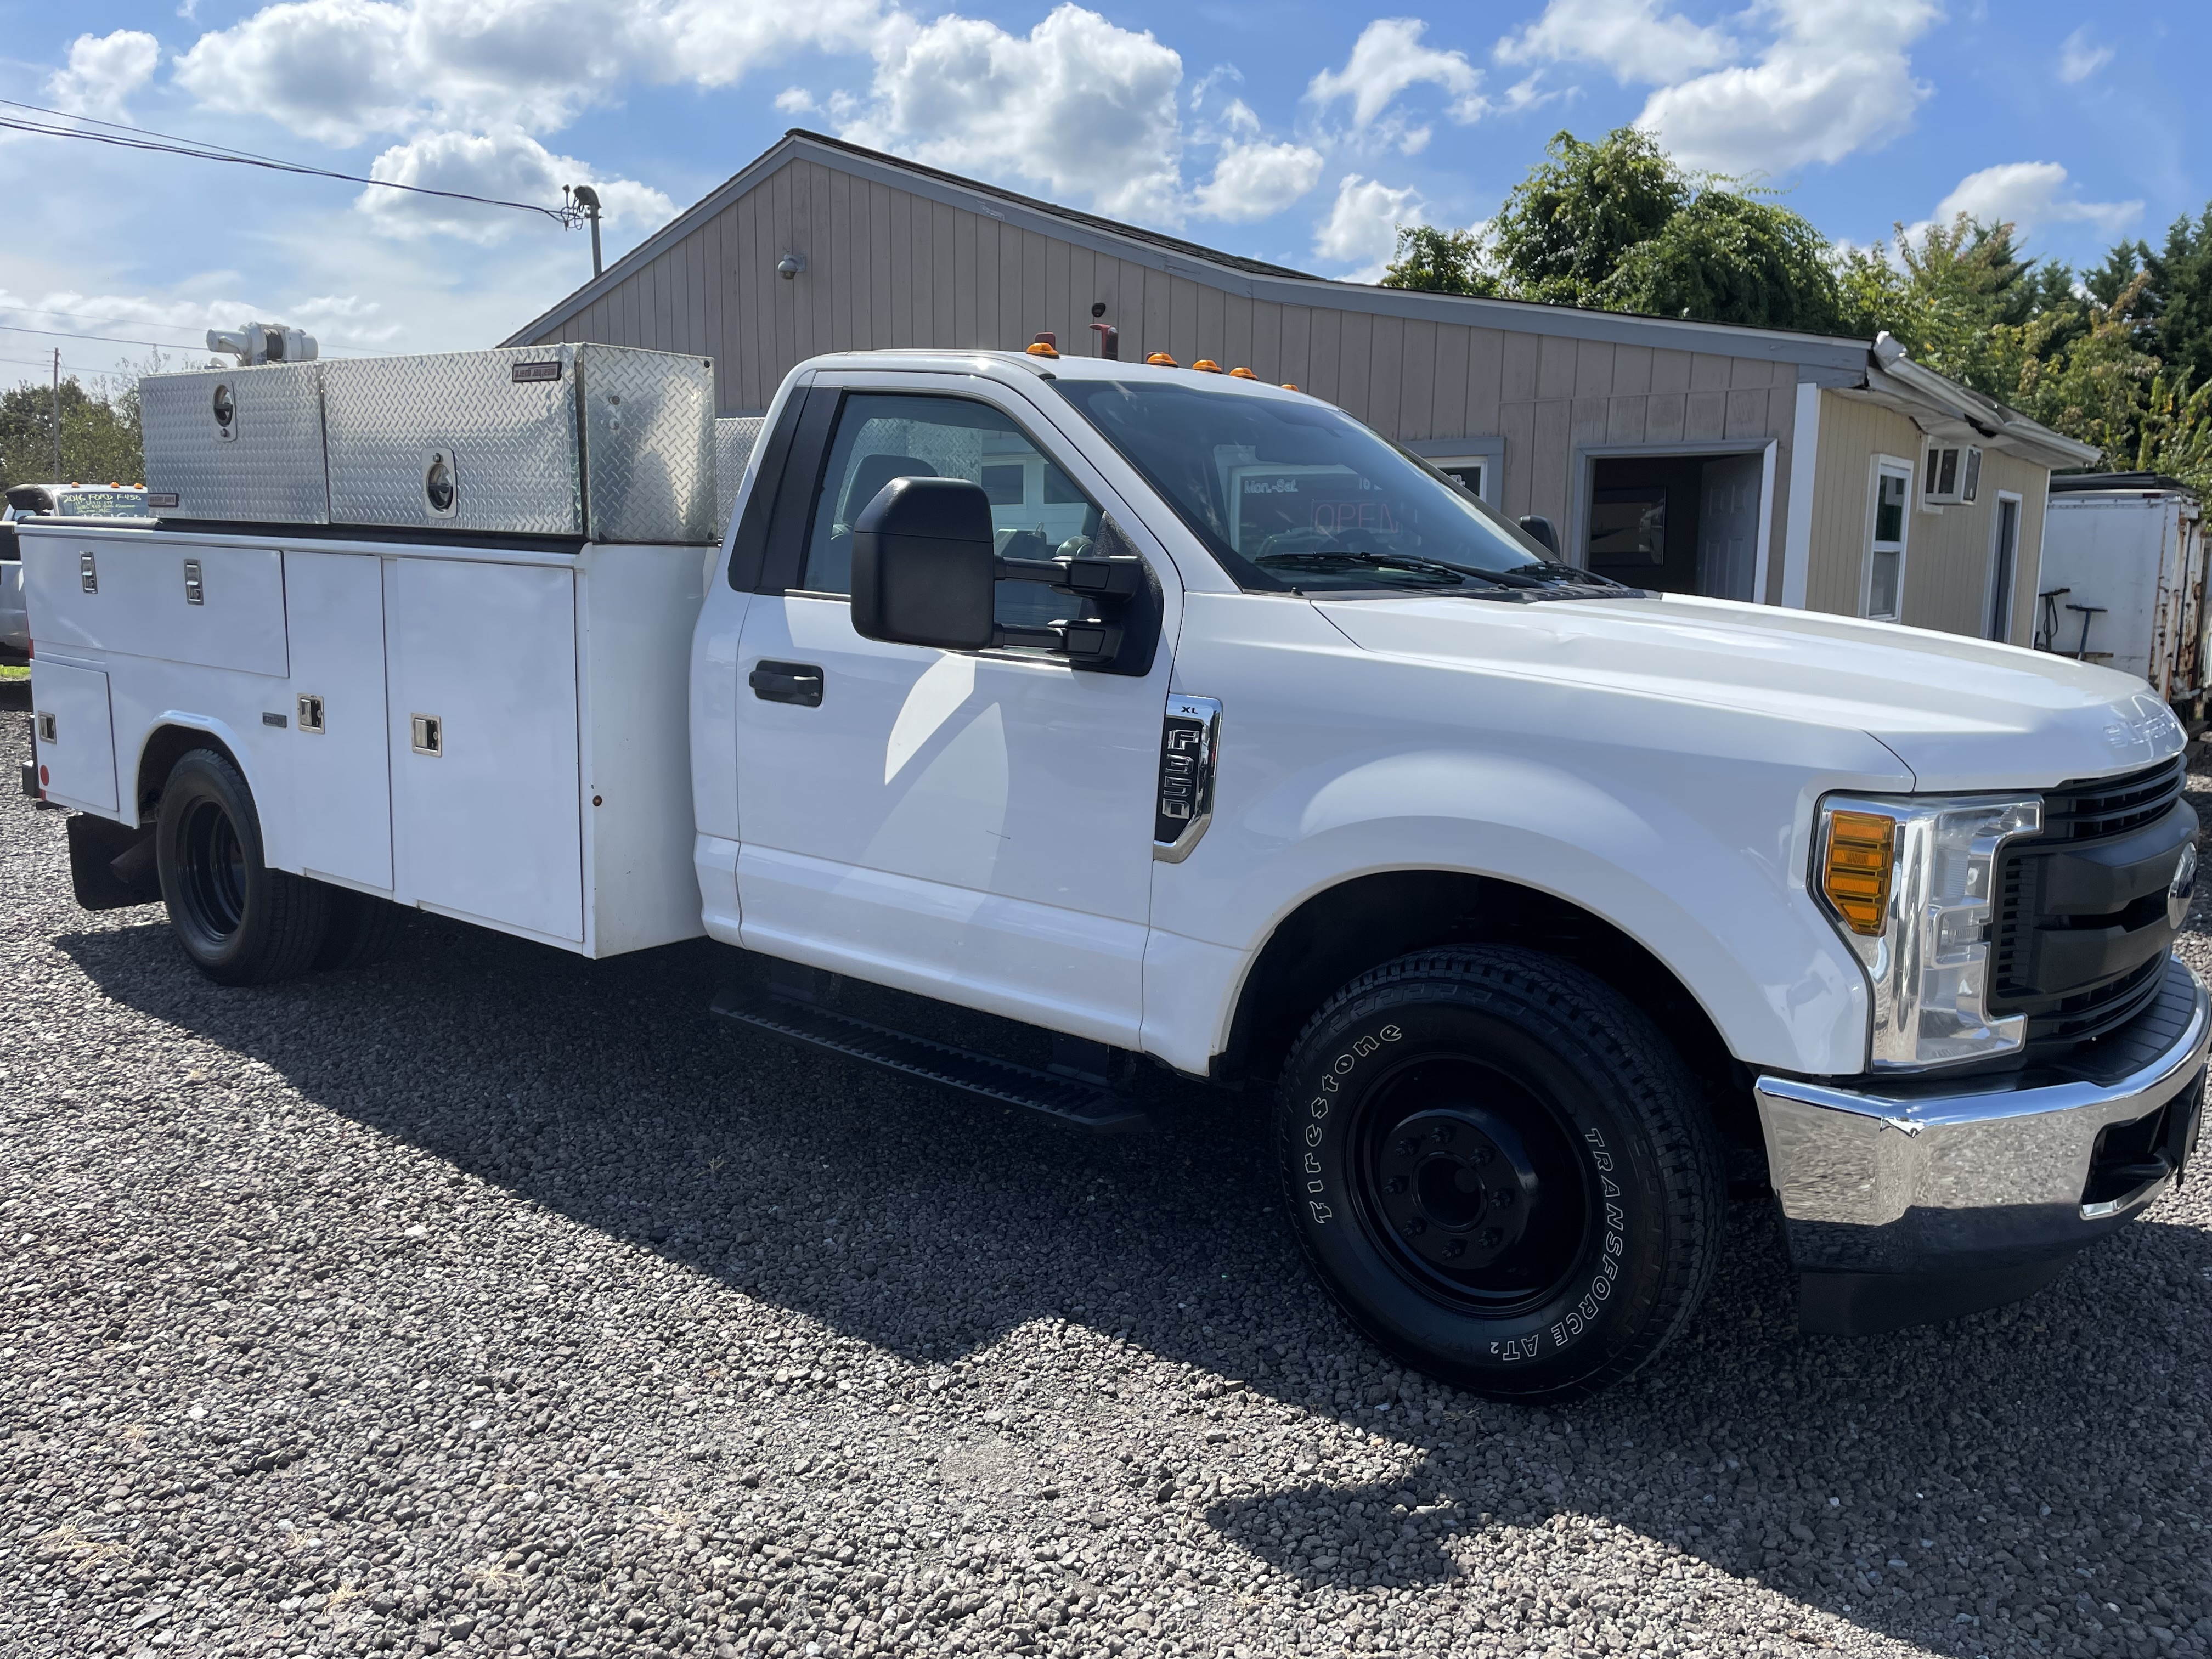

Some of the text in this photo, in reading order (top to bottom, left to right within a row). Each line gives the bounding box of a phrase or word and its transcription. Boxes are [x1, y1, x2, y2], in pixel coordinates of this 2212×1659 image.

[515, 367, 556, 379] weather guard
[1359, 478, 1371, 490] 10
[63, 494, 86, 503] 2016
[1314, 503, 1399, 534] OPEN
[1181, 706, 1199, 714] XL
[1161, 729, 1200, 820] F350
[1304, 1024, 1402, 1224] Firestone
[1551, 1128, 1623, 1347] TRANSFORCE
